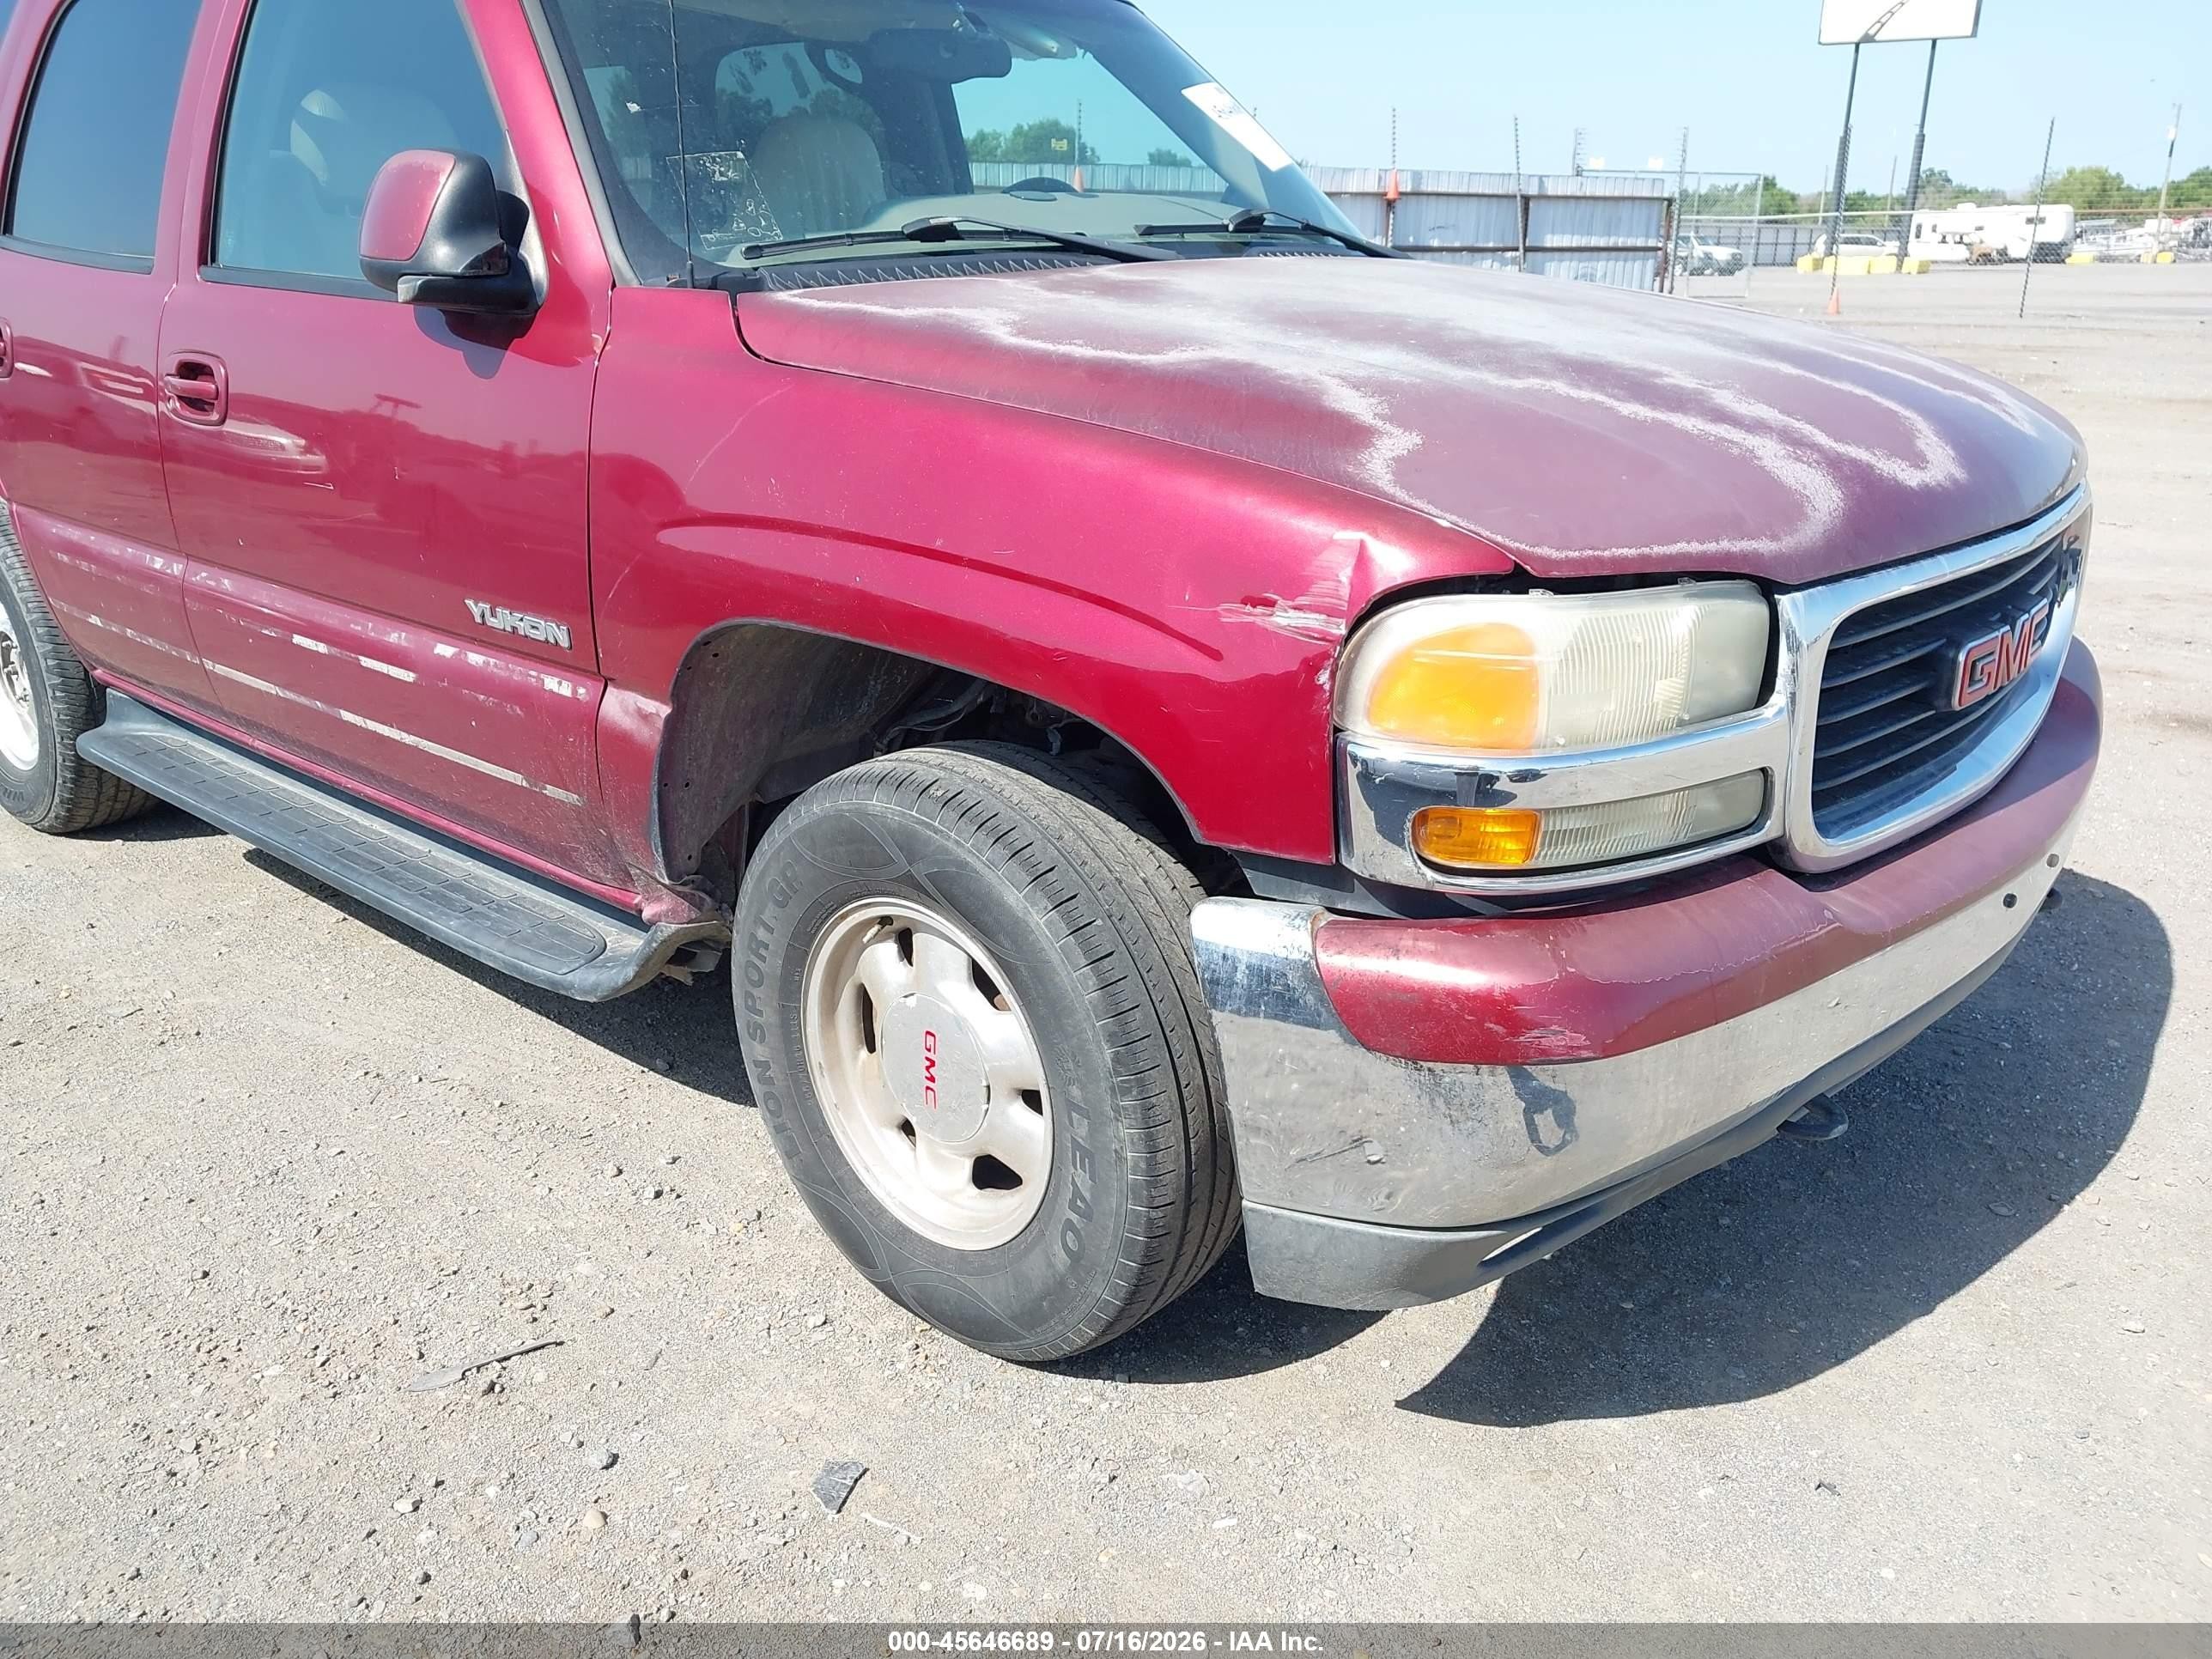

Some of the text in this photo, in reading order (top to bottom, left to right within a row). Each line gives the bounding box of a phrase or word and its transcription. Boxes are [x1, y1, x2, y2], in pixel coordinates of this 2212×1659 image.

[464, 599, 573, 651] YUKON
[1952, 598, 2049, 712] GMC
[743, 914, 777, 1045] SPORT
[752, 1058, 805, 1160] LION
[924, 1030, 937, 1110] GMC
[1060, 1097, 1098, 1264] LEAO
